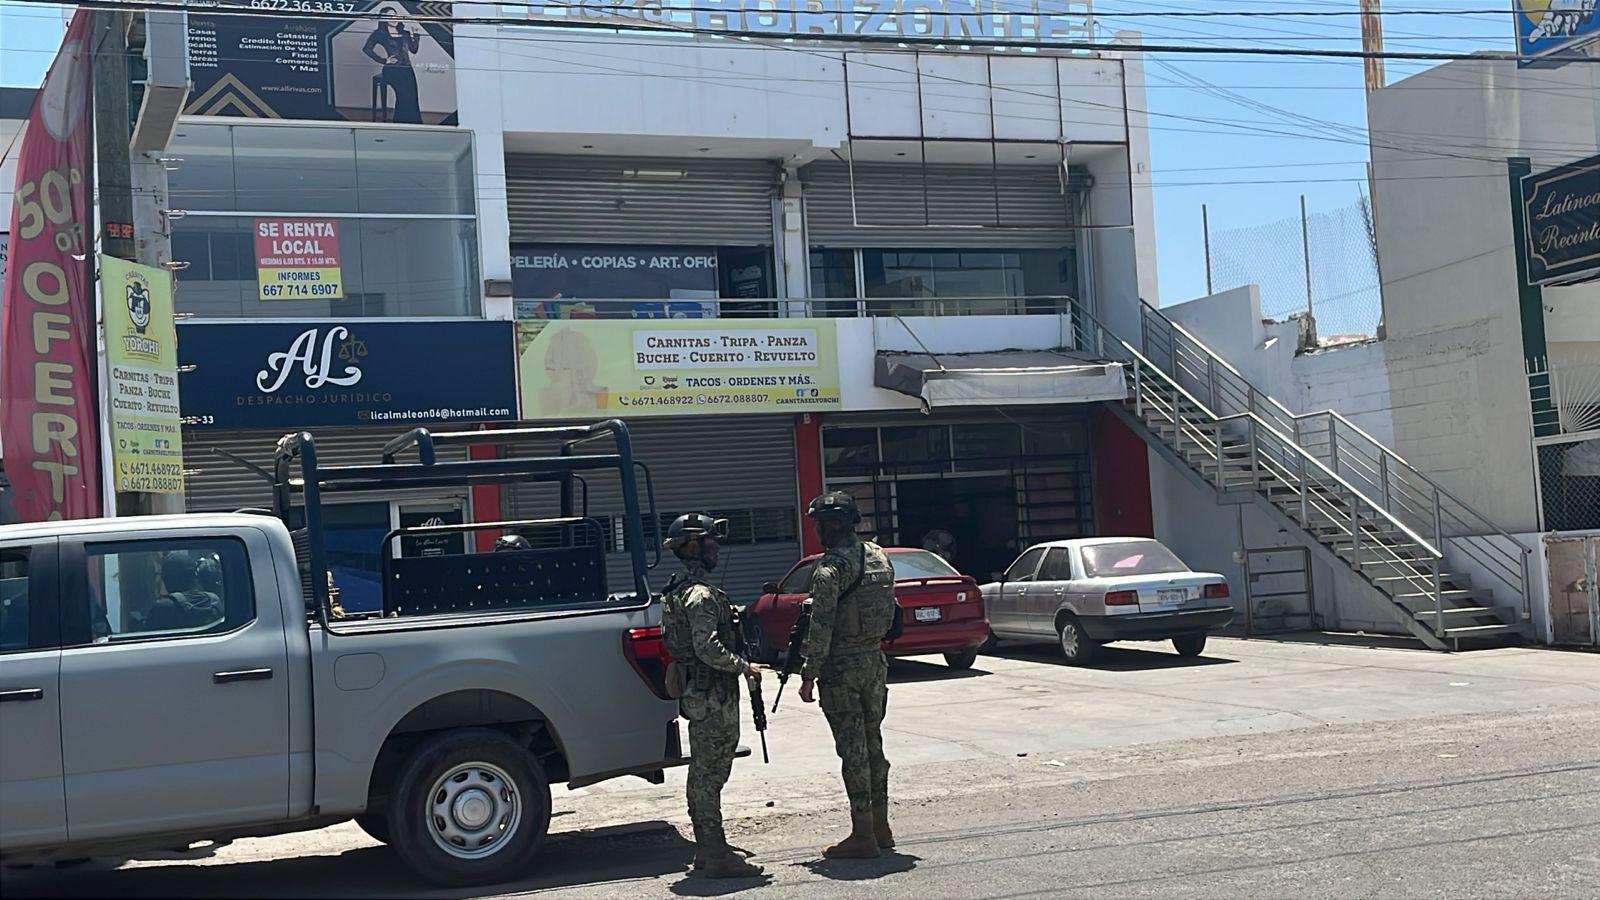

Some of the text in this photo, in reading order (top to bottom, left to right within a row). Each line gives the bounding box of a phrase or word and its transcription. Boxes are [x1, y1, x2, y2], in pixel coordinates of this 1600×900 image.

[241, 37, 318, 47] Credito Infonavit
[276, 32, 318, 40] Catastral
[259, 222, 335, 238] SE RENTA
[272, 240, 324, 255] LOCAL
[581, 256, 636, 269] COPIAS
[649, 256, 681, 269] ART.
[277, 272, 321, 281] INFORMES
[263, 284, 338, 296] 667 714 6907
[123, 336, 160, 355] YORCHI
[647, 335, 808, 348] CARNITAS TRIPA PANZA
[256, 326, 362, 393] AL
[636, 350, 816, 364] BUCHE CUERITO REVUELTO
[113, 368, 174, 386] CARNITAS TRIPA
[686, 377, 721, 387] TACOS
[728, 376, 777, 387] ORDENES
[779, 376, 786, 386] Y
[22, 261, 79, 521] OFERT
[119, 383, 171, 400] PANZA BUCHE
[113, 398, 178, 414] CUERITO REVUELTO
[236, 395, 316, 406] DESPACHO
[631, 395, 694, 406] 6671.468922
[370, 408, 510, 420] licalmaleon06@hotmail.com
[116, 421, 134, 430] TACOS
[130, 461, 180, 476] 6671.468922
[131, 477, 182, 490] 6672.088807
